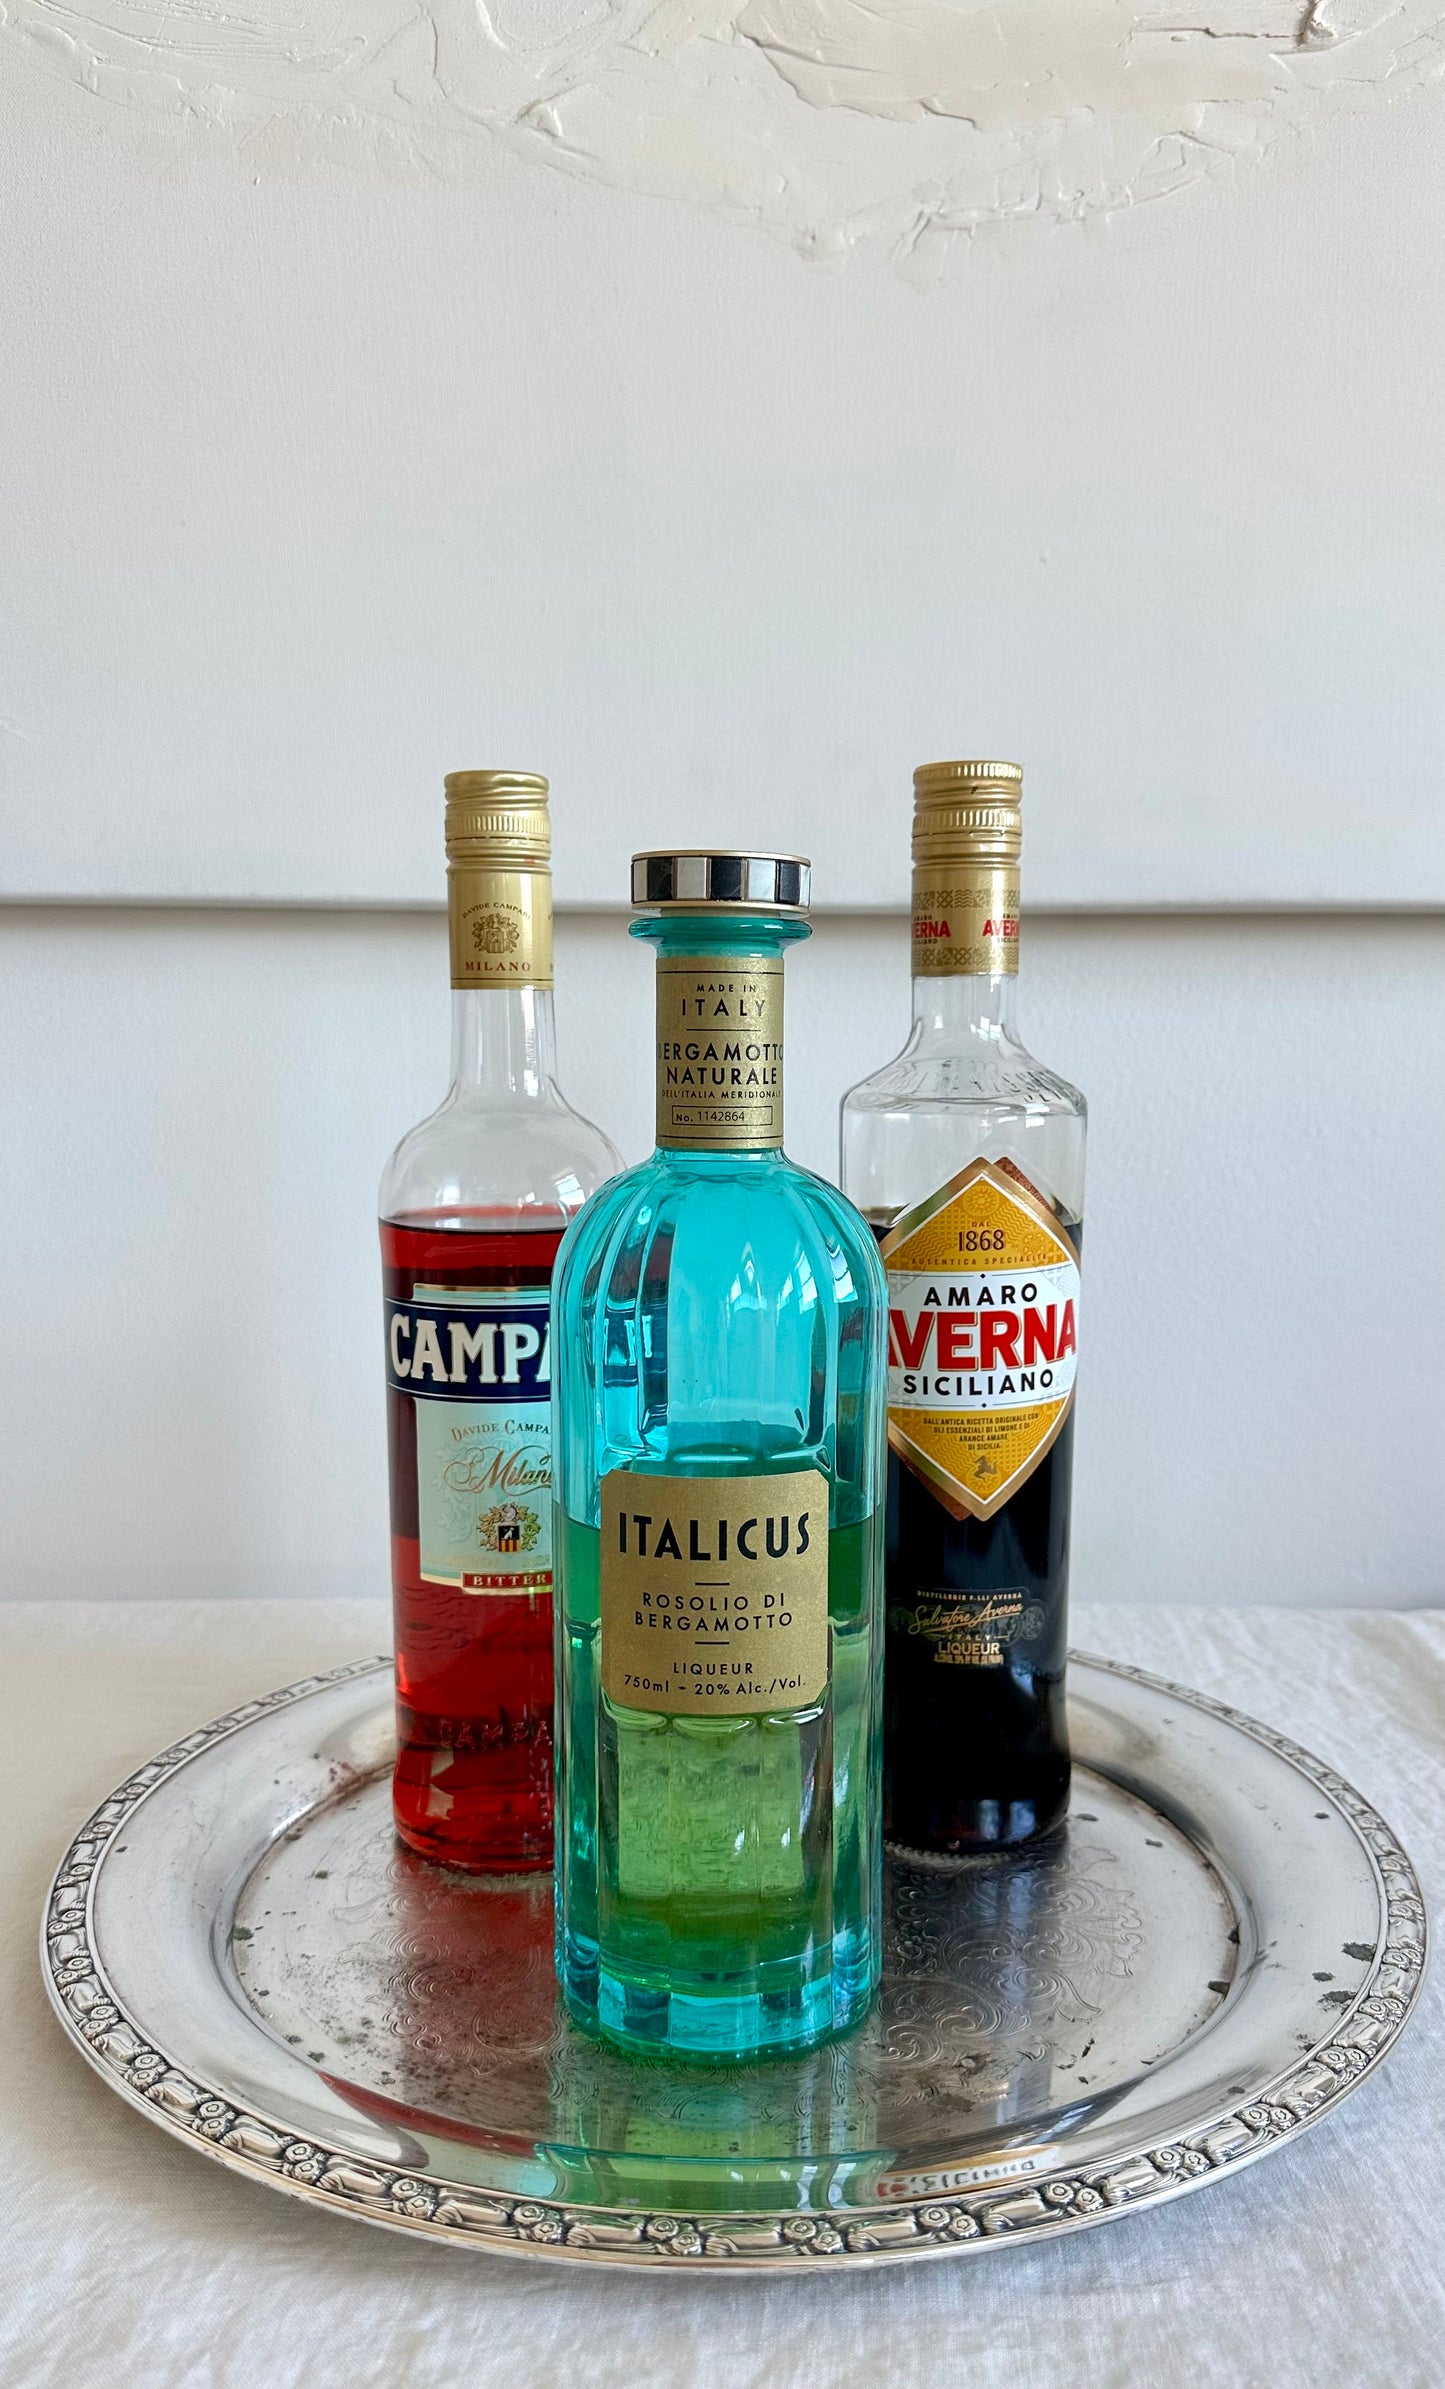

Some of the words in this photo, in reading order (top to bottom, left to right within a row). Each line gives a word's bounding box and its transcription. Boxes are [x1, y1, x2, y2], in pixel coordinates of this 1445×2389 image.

[463, 902, 490, 919] DAVIDE
[465, 961, 531, 972] MILANO
[697, 984, 734, 993] MADE
[743, 985, 757, 993] IN
[682, 998, 766, 1017] ITALY
[667, 1066, 778, 1085] NATURALE
[662, 1089, 715, 1099] DELL'ITALIA
[676, 1113, 693, 1122] No.
[698, 1111, 745, 1122] 1142864
[958, 1229, 1005, 1252] 1868
[911, 1257, 977, 1266] AUTENTICA
[924, 1283, 1038, 1307] AMARO
[903, 1369, 1053, 1396] SICILIANO
[994, 1423, 1018, 1433] LIMONE
[619, 1511, 810, 1561] ITALICUS
[473, 1573, 547, 1586] BITTER
[643, 1592, 749, 1612] ROSOLIO
[764, 1592, 785, 1608] DI
[635, 1611, 793, 1632] BERGAMOTTO
[908, 1605, 971, 1634] Salvatore
[968, 1600, 1024, 1628] Averna
[938, 1641, 1000, 1655] LIQUEUR
[673, 1662, 754, 1676] LIQUEUR
[624, 1674, 670, 1693] 750ml
[694, 1683, 731, 1696] 20%
